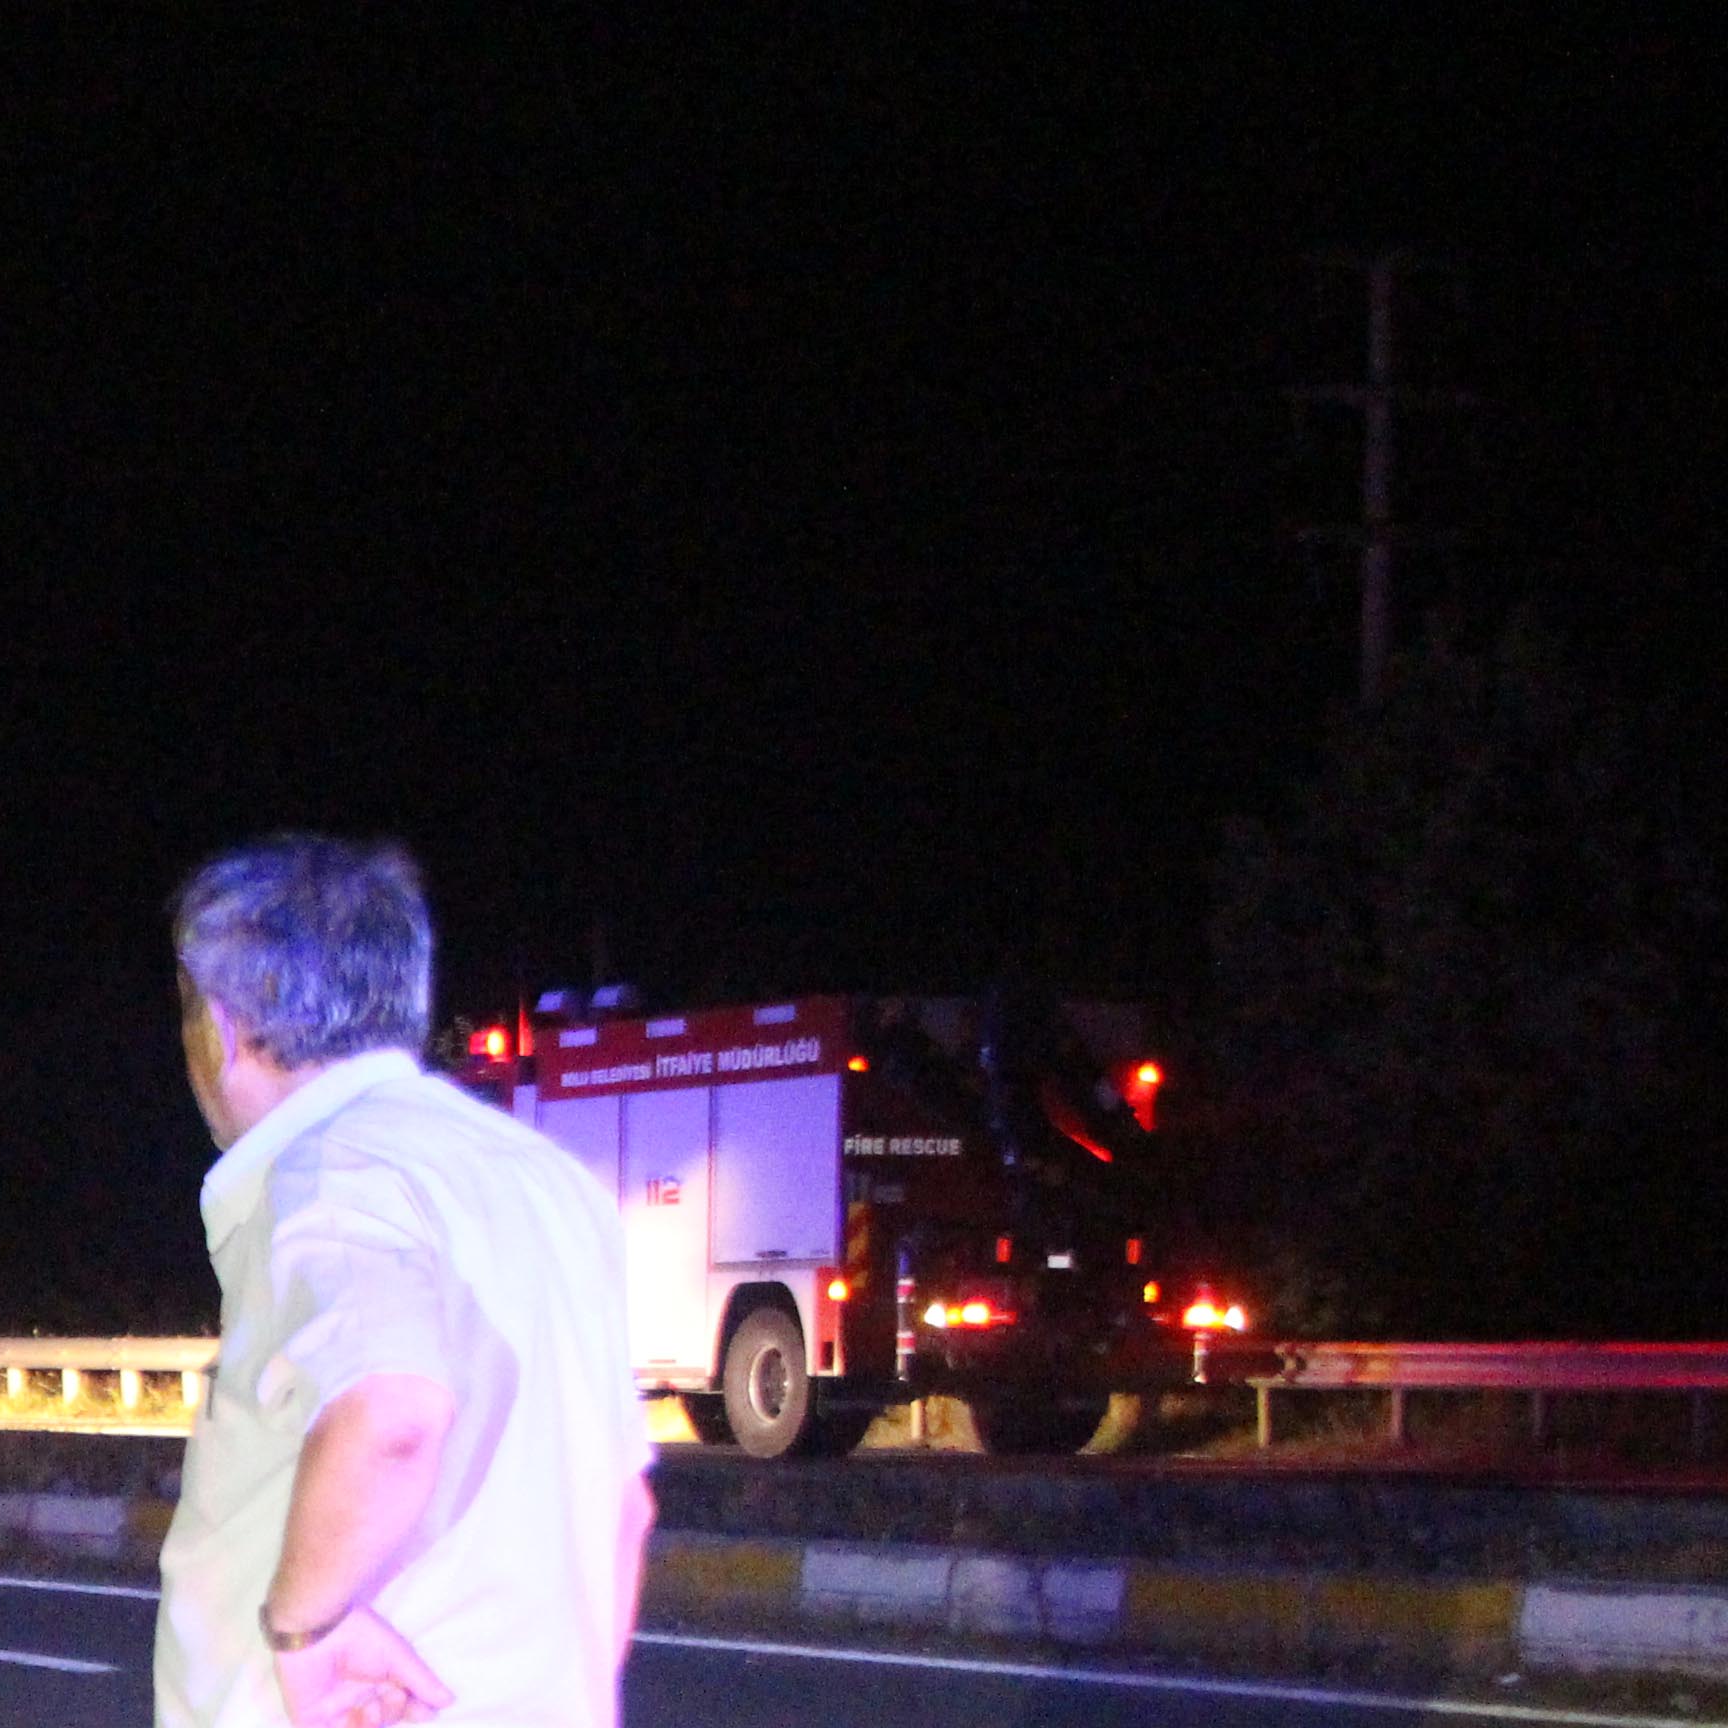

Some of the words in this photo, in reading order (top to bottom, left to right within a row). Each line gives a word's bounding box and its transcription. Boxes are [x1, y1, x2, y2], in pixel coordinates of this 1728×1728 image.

[656, 1051, 713, 1078] İTFAİYE
[717, 1036, 821, 1072] MÜDÜRLÜĞÜ
[889, 1137, 960, 1156] RESCUE
[646, 1178, 680, 1206] 112
